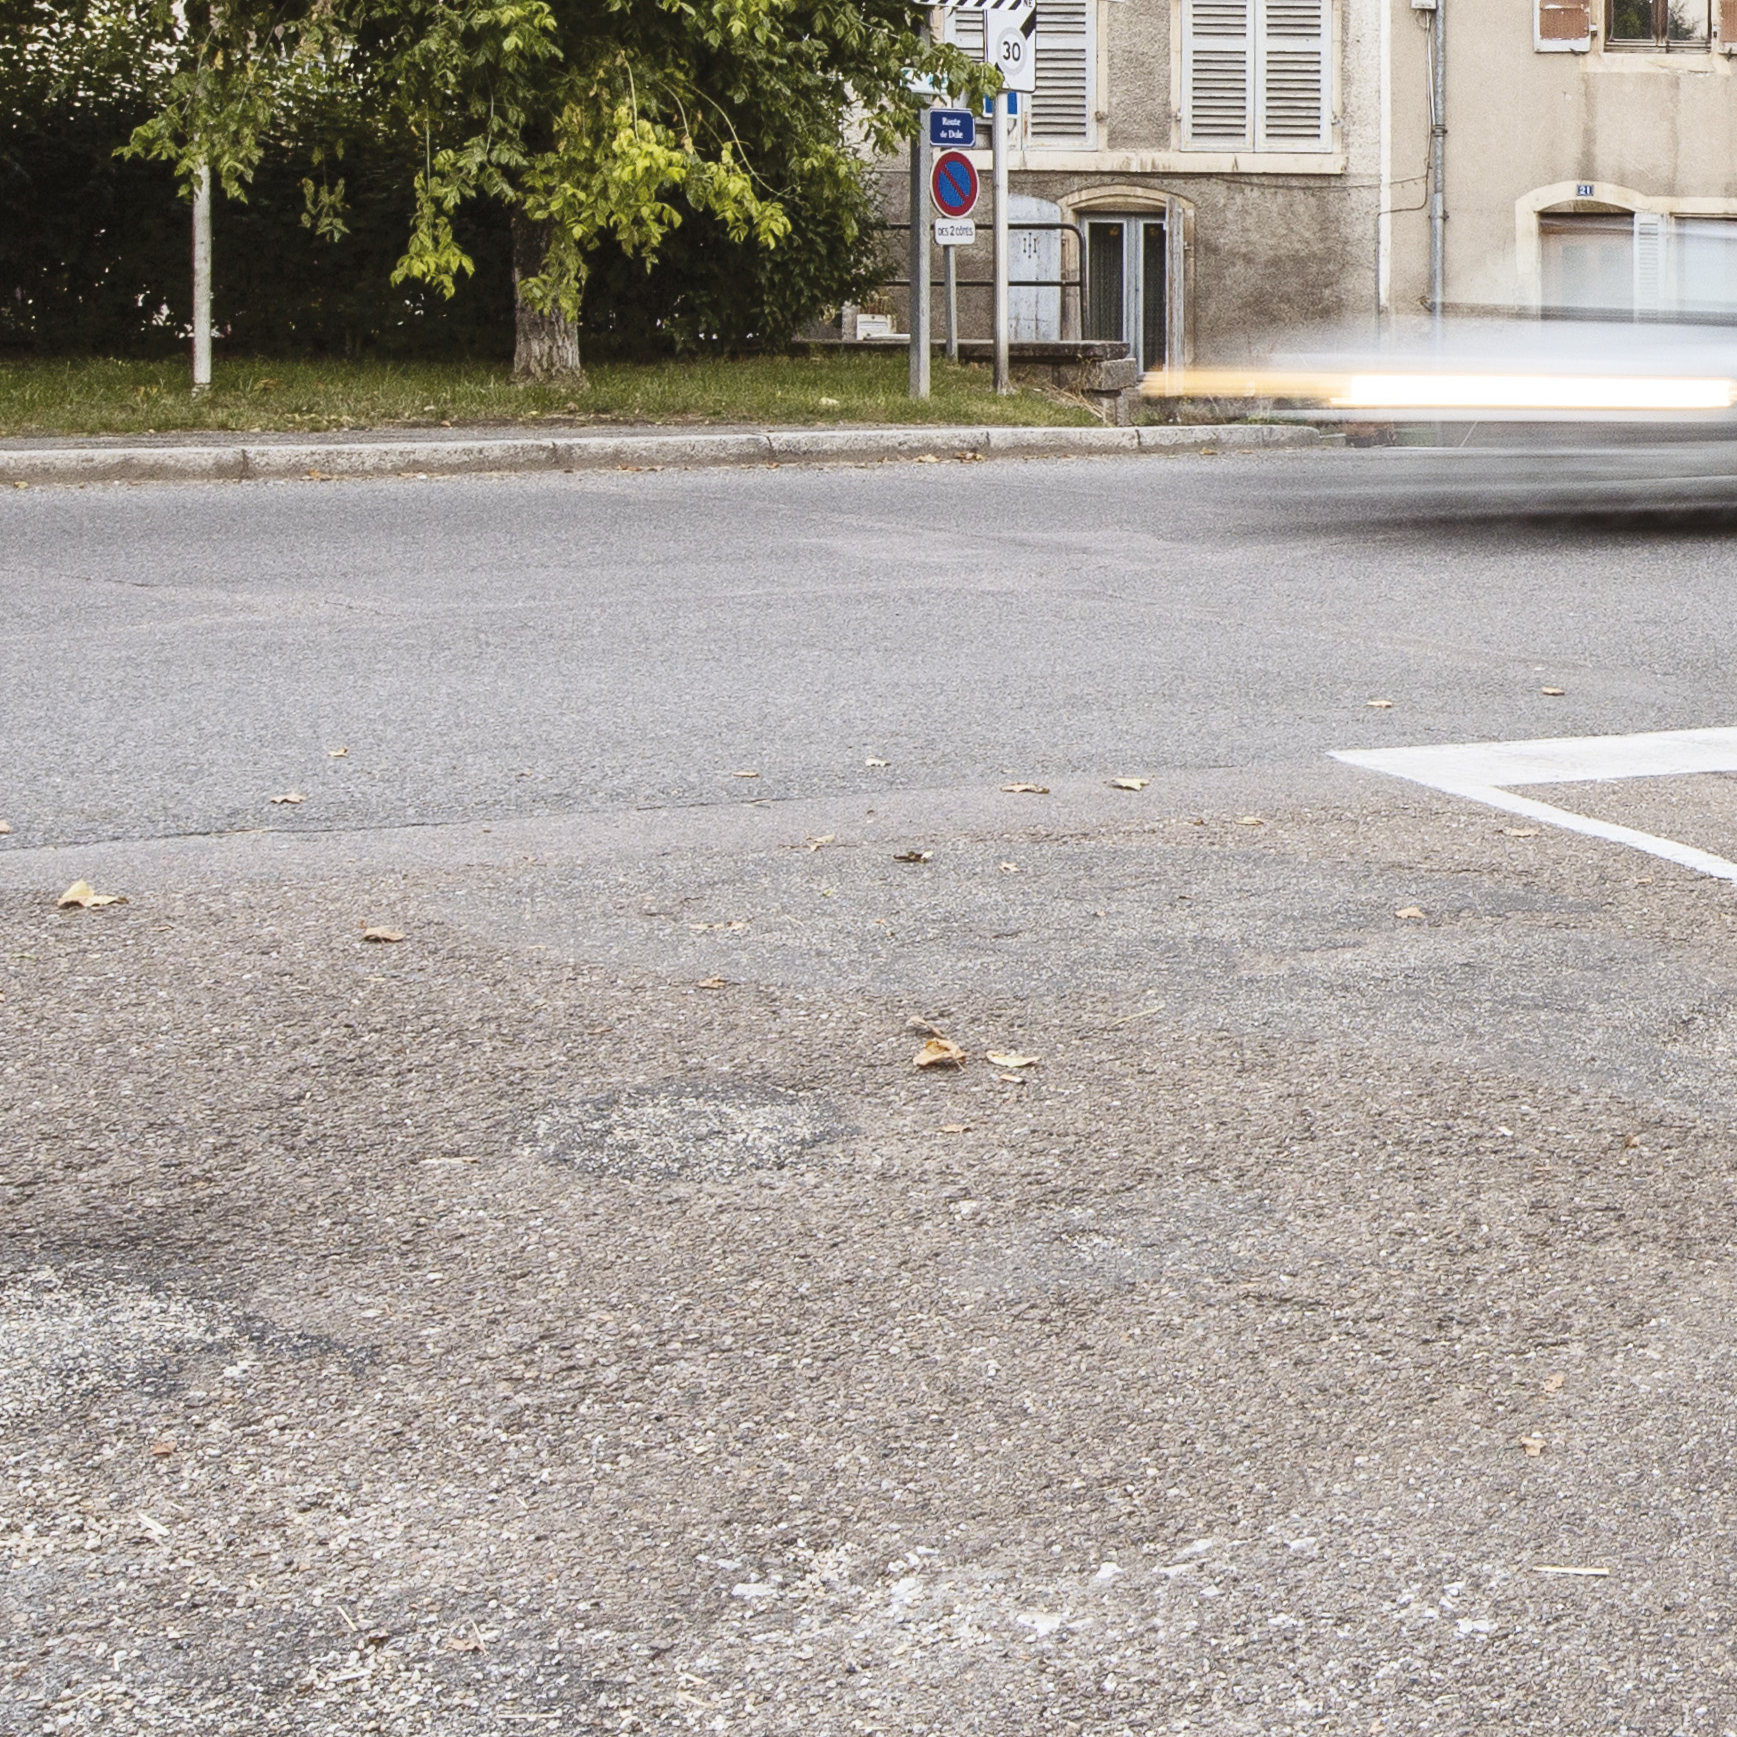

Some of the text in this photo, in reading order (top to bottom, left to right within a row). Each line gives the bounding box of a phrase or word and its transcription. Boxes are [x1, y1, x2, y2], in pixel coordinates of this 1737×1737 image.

[1002, 40, 1021, 62] 30
[941, 116, 961, 126] Route
[939, 130, 947, 139] de
[1580, 185, 1590, 194] 21
[938, 227, 949, 236] DES
[949, 225, 955, 236] 2
